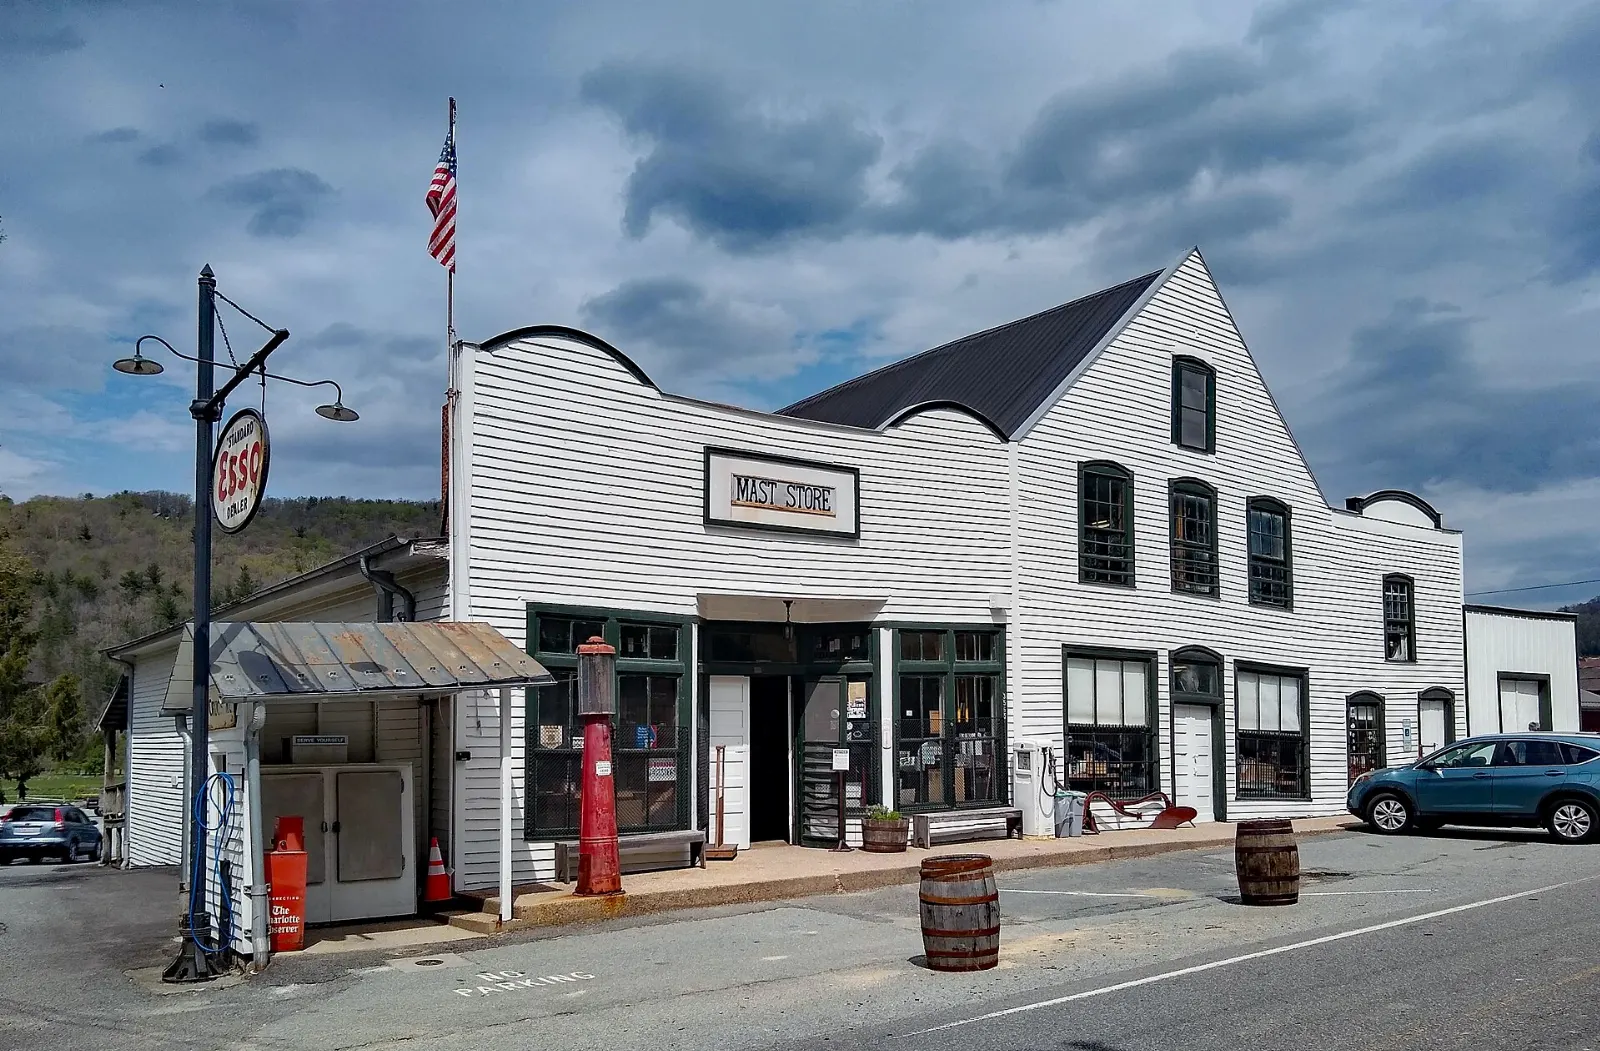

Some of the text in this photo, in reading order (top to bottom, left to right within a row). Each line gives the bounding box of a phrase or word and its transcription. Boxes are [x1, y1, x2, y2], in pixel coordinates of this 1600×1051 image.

[227, 421, 254, 448] STANDARD
[736, 476, 831, 511] MAST STORE
[226, 497, 248, 520] DEALER
[272, 905, 290, 915] The
[269, 915, 300, 924] harlotte
[268, 926, 298, 935] bserver
[452, 971, 595, 997] PARKING
[475, 970, 526, 982] NO
